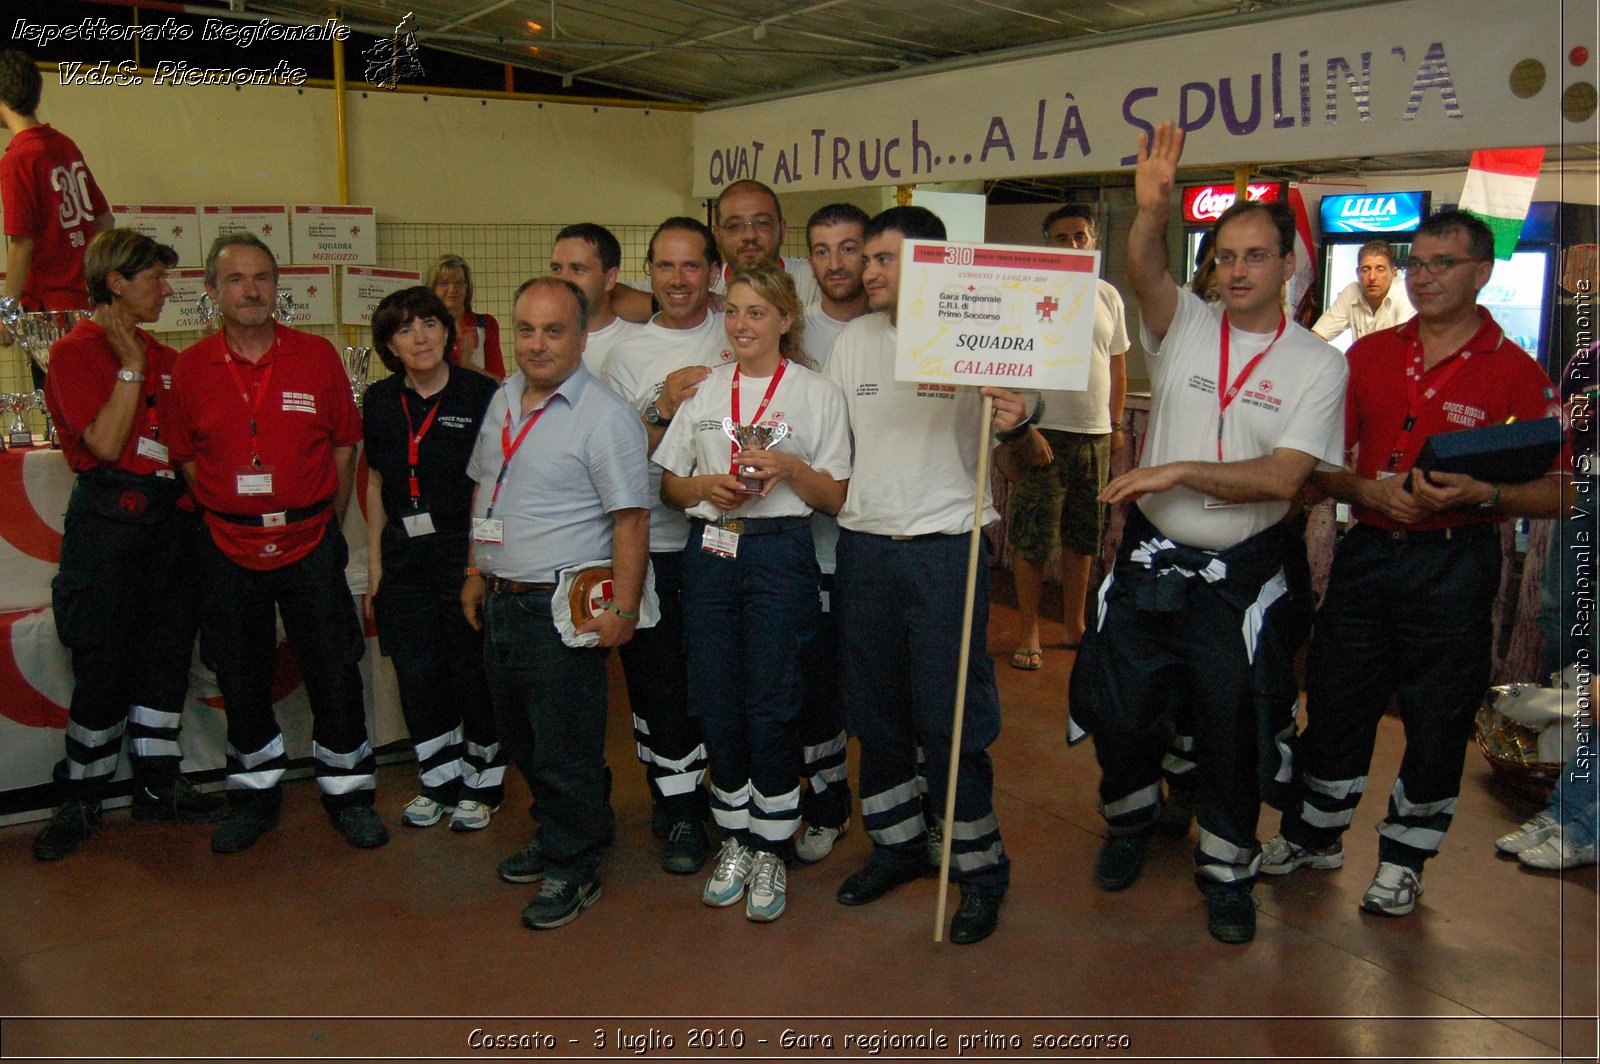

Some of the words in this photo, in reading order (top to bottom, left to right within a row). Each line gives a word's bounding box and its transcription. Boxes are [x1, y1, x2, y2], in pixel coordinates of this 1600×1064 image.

[709, 141, 764, 185] QUAT
[773, 142, 803, 184] AL
[1340, 197, 1397, 217] LILIA
[318, 242, 352, 250] SQUADRA
[312, 253, 359, 261] MERGOZZO
[958, 271, 993, 280] COSSATO
[1002, 273, 1031, 282] LUGLIO
[939, 292, 960, 302] Gara
[962, 294, 1002, 304] Regionale
[938, 301, 960, 310] C.R.I.
[961, 302, 969, 310] di
[938, 310, 962, 319] Primo
[963, 311, 1001, 321] Soccorso
[956, 334, 1034, 351] SQUADRA
[953, 360, 1034, 377] CALABRIA
[1442, 401, 1464, 414] CROCE
[1464, 406, 1485, 421] ROSSA
[1446, 412, 1476, 429] ITALIANA
